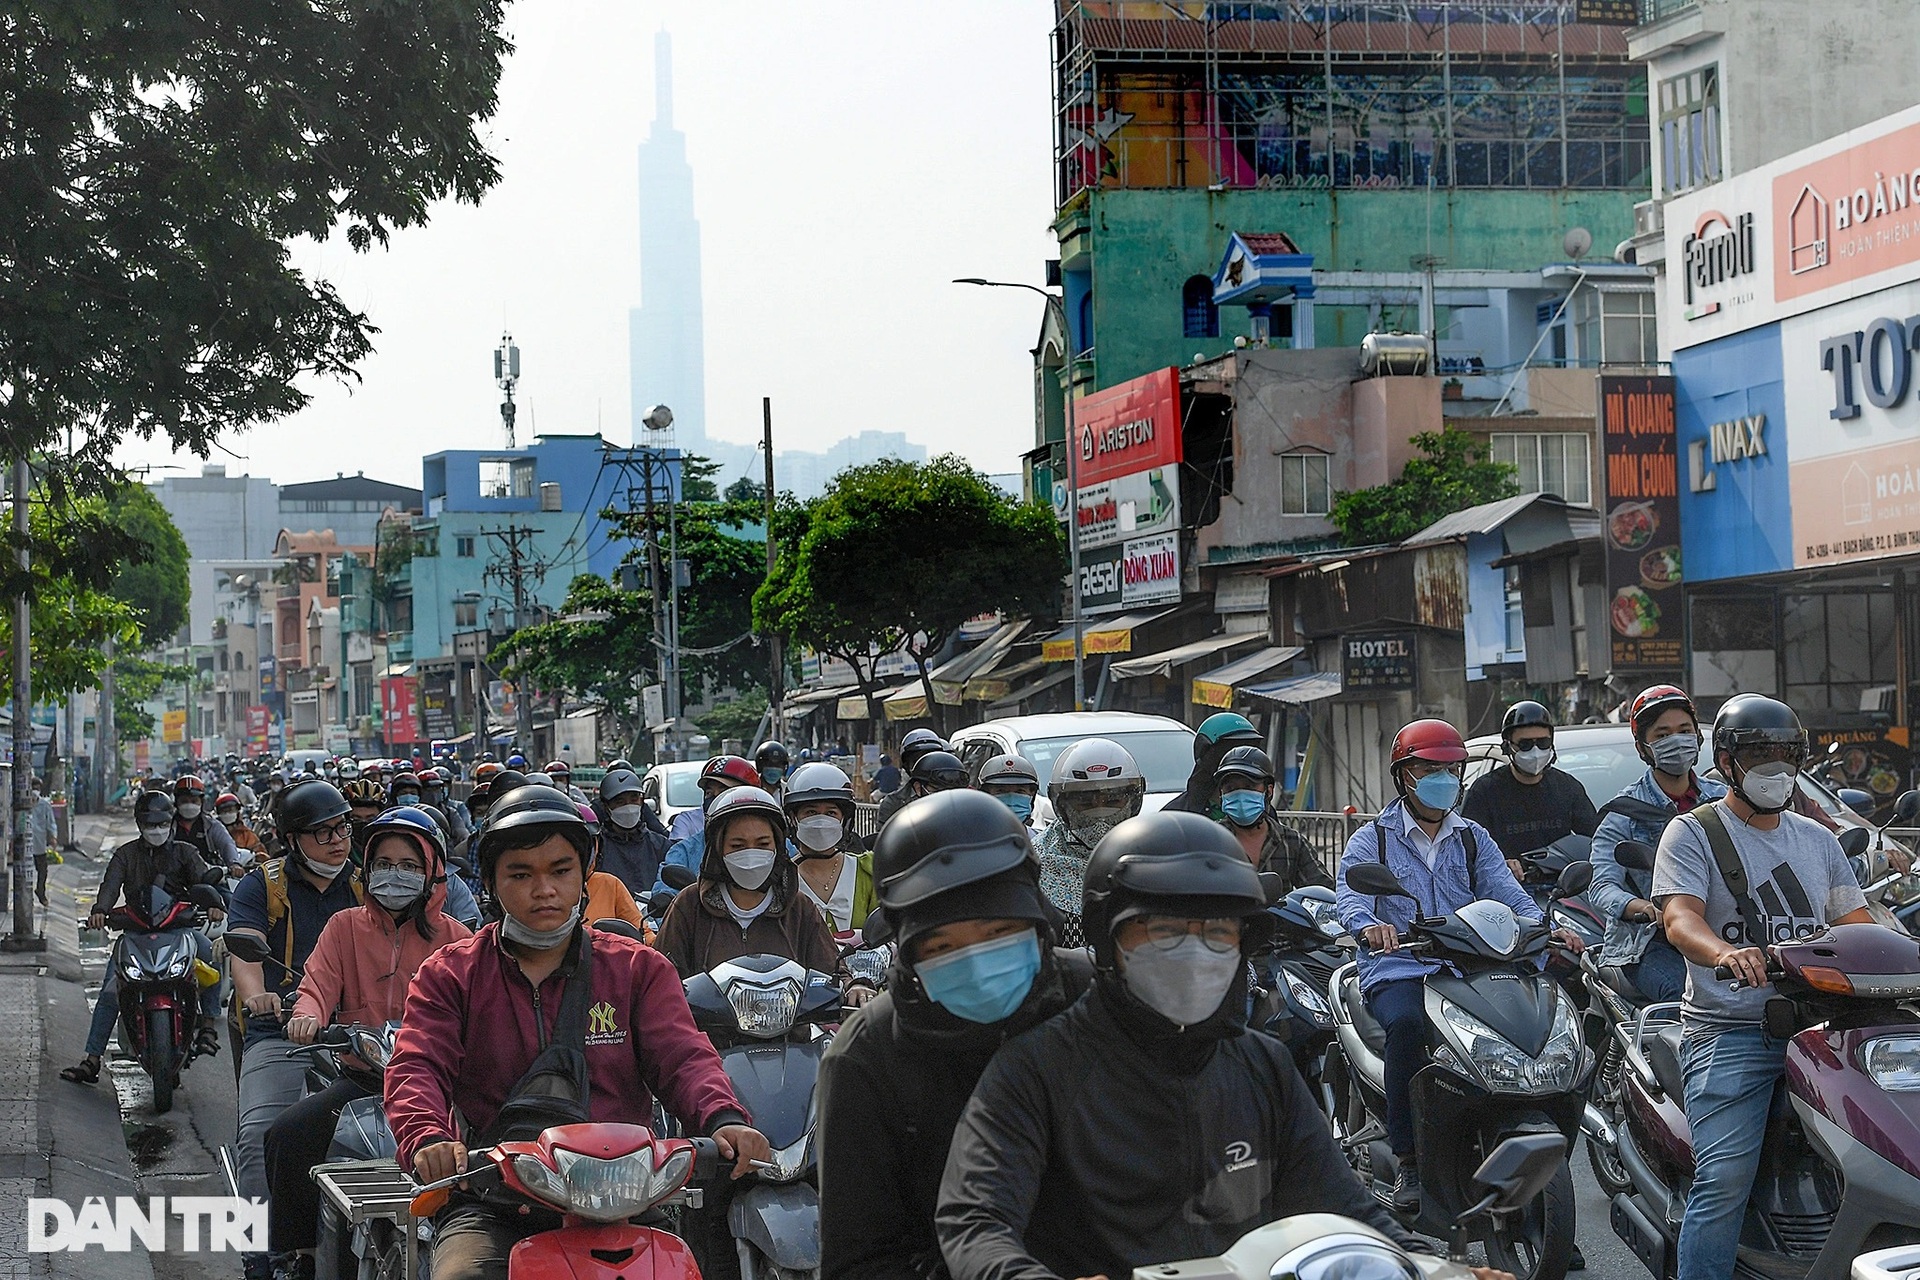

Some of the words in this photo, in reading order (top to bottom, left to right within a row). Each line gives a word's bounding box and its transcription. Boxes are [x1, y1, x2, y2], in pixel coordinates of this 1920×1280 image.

[1606, 384, 1625, 434] MÌ
[1628, 380, 1674, 438] QUẢNG
[1097, 416, 1154, 454] ARISTON
[1710, 414, 1767, 463] INAX
[1608, 444, 1638, 497] MÓN
[1641, 438, 1676, 497] CUỐN
[1348, 640, 1409, 658] HOTEL
[1434, 1077, 1466, 1097] HONDA
